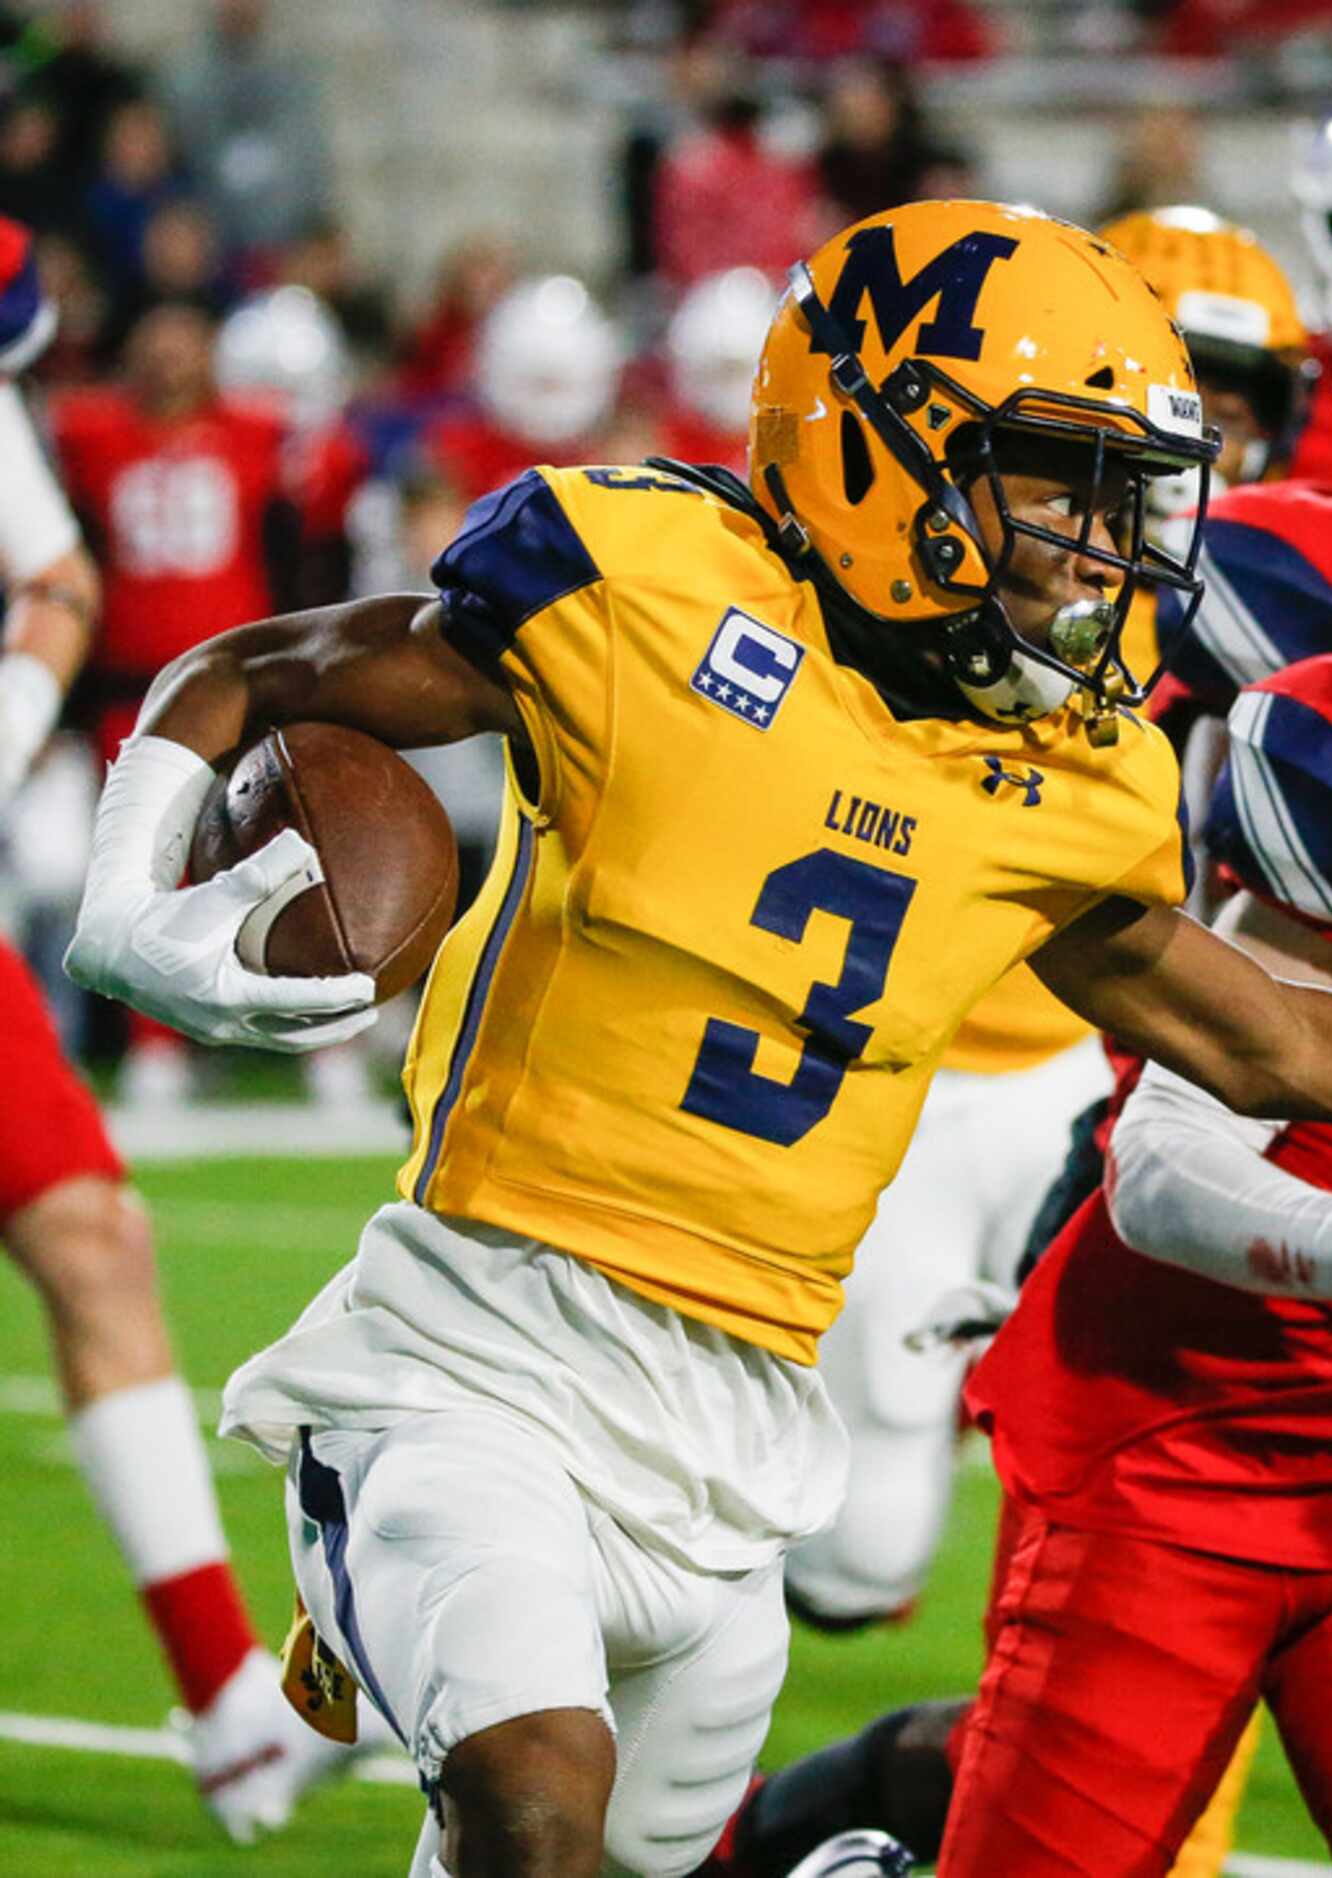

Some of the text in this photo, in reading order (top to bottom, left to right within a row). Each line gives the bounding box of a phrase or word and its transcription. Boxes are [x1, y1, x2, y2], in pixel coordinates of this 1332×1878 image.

[809, 224, 1020, 362] M
[709, 614, 798, 703] C
[824, 789, 917, 856] LIONS
[679, 847, 918, 1147] 3
